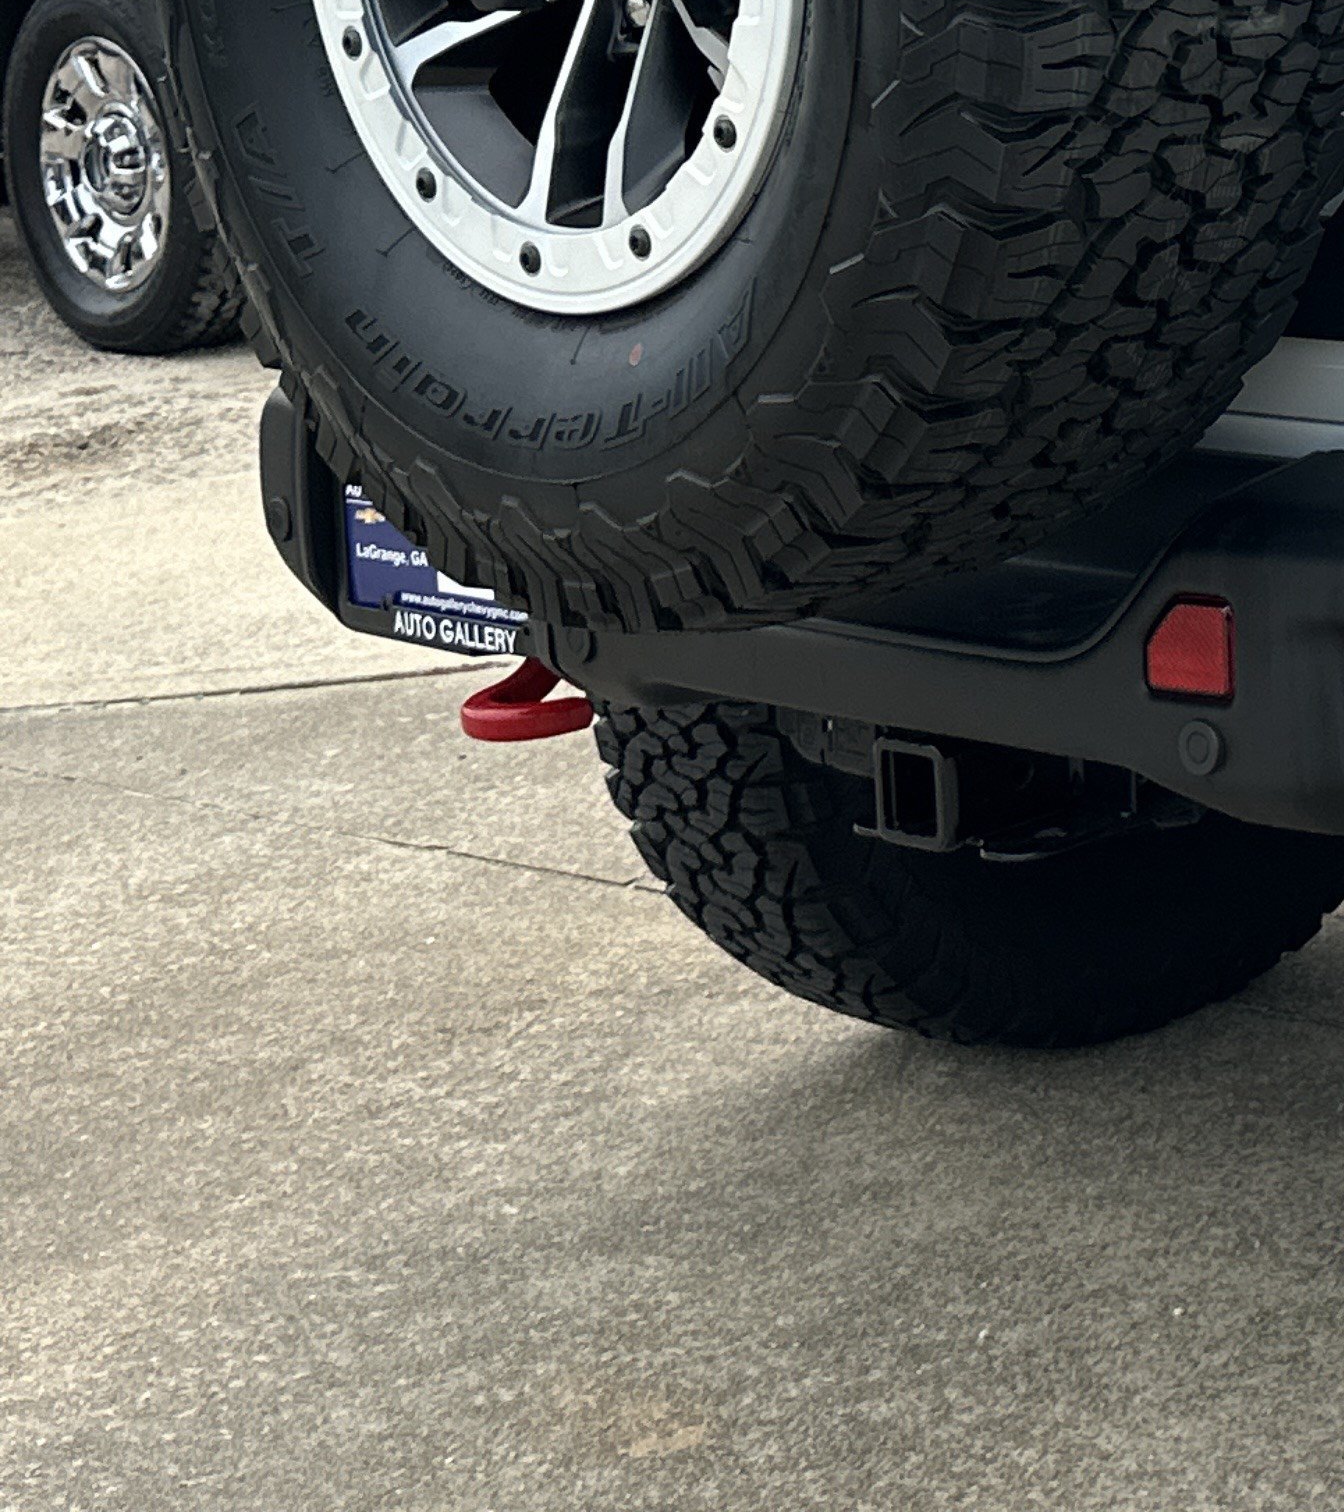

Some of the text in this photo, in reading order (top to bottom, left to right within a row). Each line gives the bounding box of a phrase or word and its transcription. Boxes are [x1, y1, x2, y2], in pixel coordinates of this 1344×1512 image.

[355, 542, 429, 567] LaGrange, GA
[393, 610, 517, 653] AUTO GALLERY
